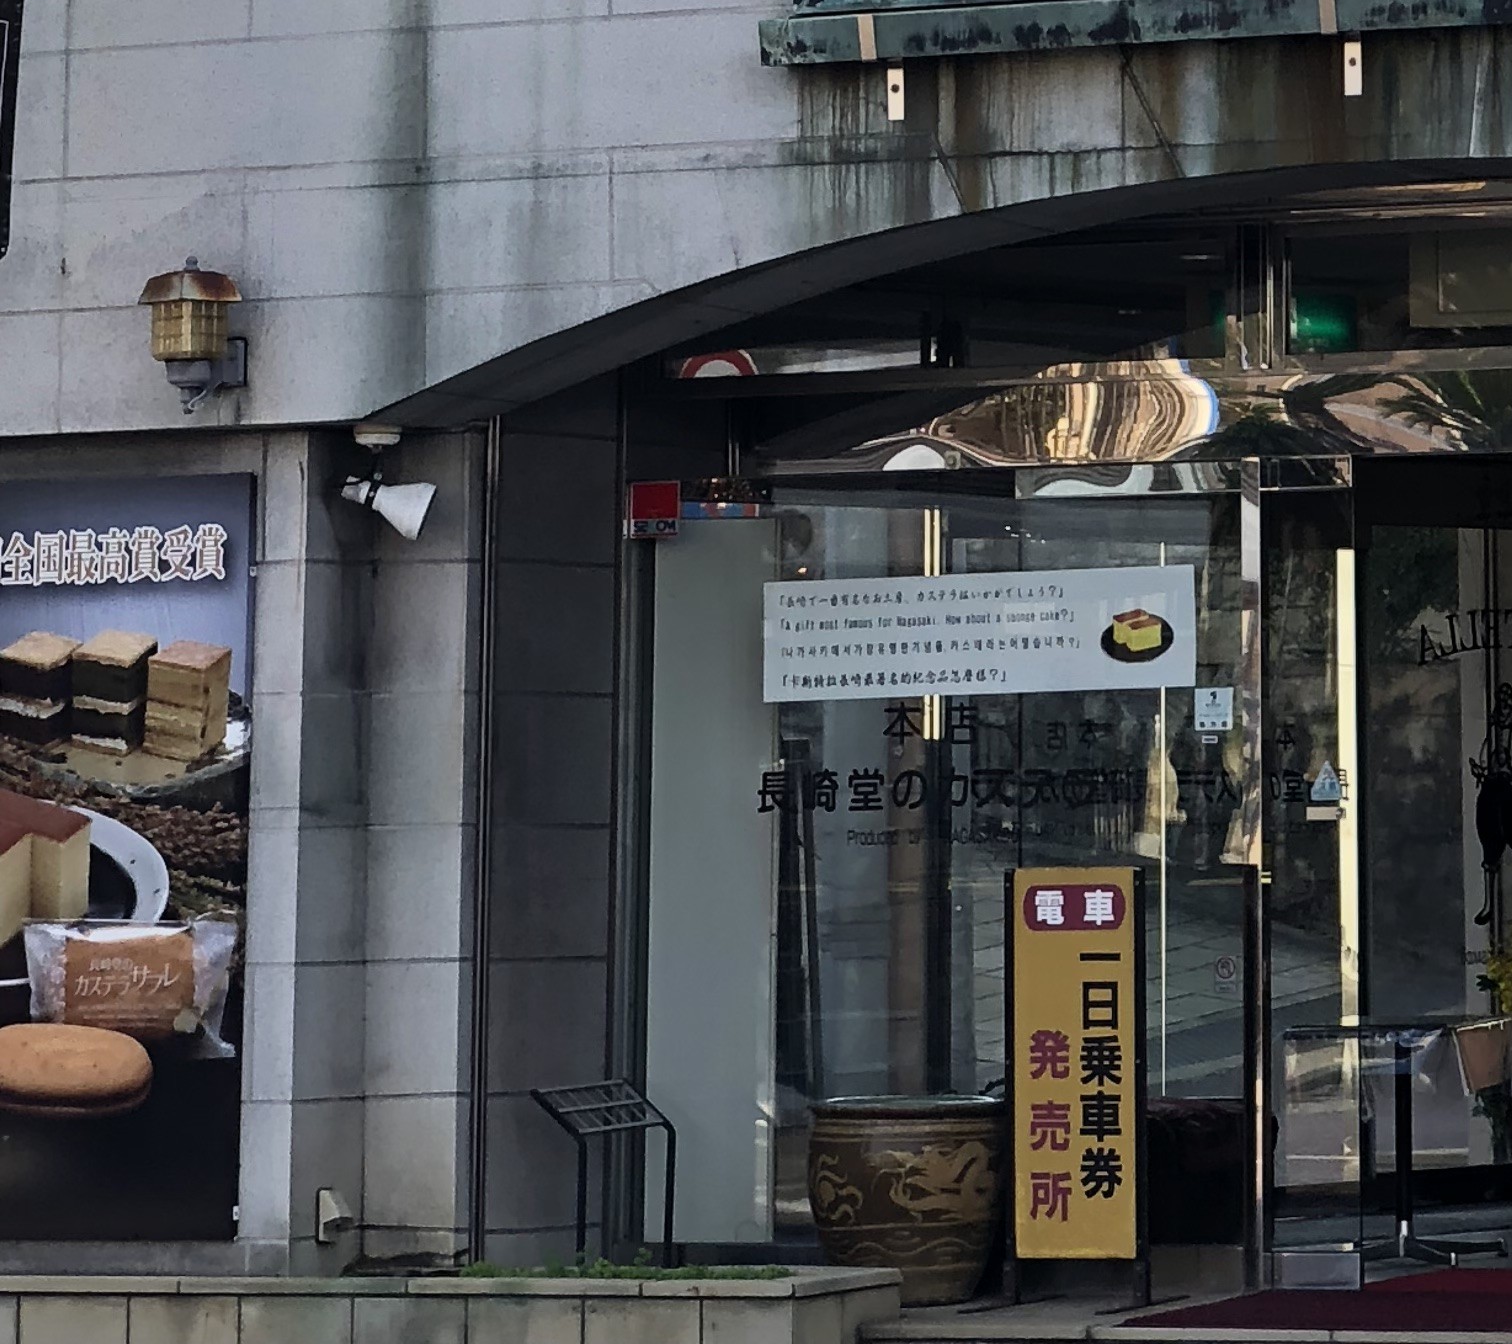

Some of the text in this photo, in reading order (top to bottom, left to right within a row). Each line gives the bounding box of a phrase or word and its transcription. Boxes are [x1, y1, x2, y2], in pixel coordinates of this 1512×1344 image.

[0, 523, 227, 586] 全国最高賞受賞
[1034, 888, 1115, 926] 電車
[1029, 1029, 1073, 1223] 発売所
[1079, 951, 1124, 1199] 一日乗車券
